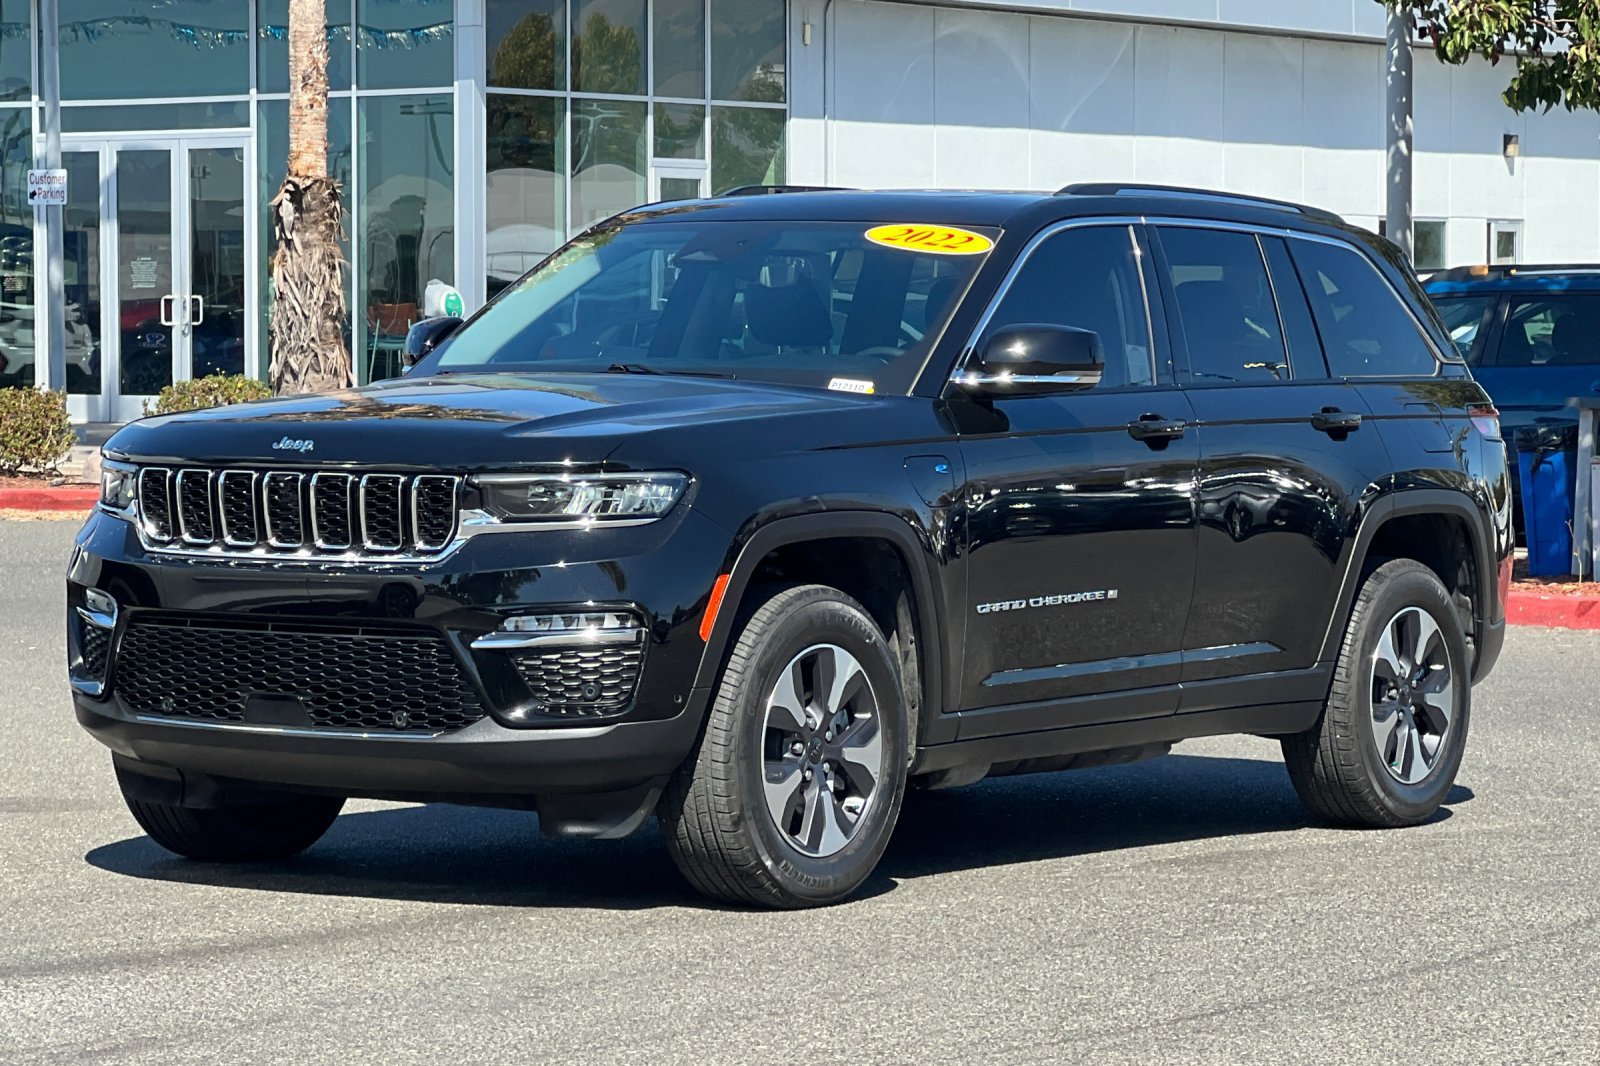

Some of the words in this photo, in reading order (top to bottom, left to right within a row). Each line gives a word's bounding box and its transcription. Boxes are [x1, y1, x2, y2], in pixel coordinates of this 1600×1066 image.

[30, 172, 65, 185] Customer
[37, 187, 65, 202] Parking
[881, 228, 975, 249] 2022
[831, 381, 865, 392] P12110
[272, 436, 314, 453] Jeep
[976, 599, 1027, 614] GRAND
[1029, 590, 1106, 608] CHEROKEE
